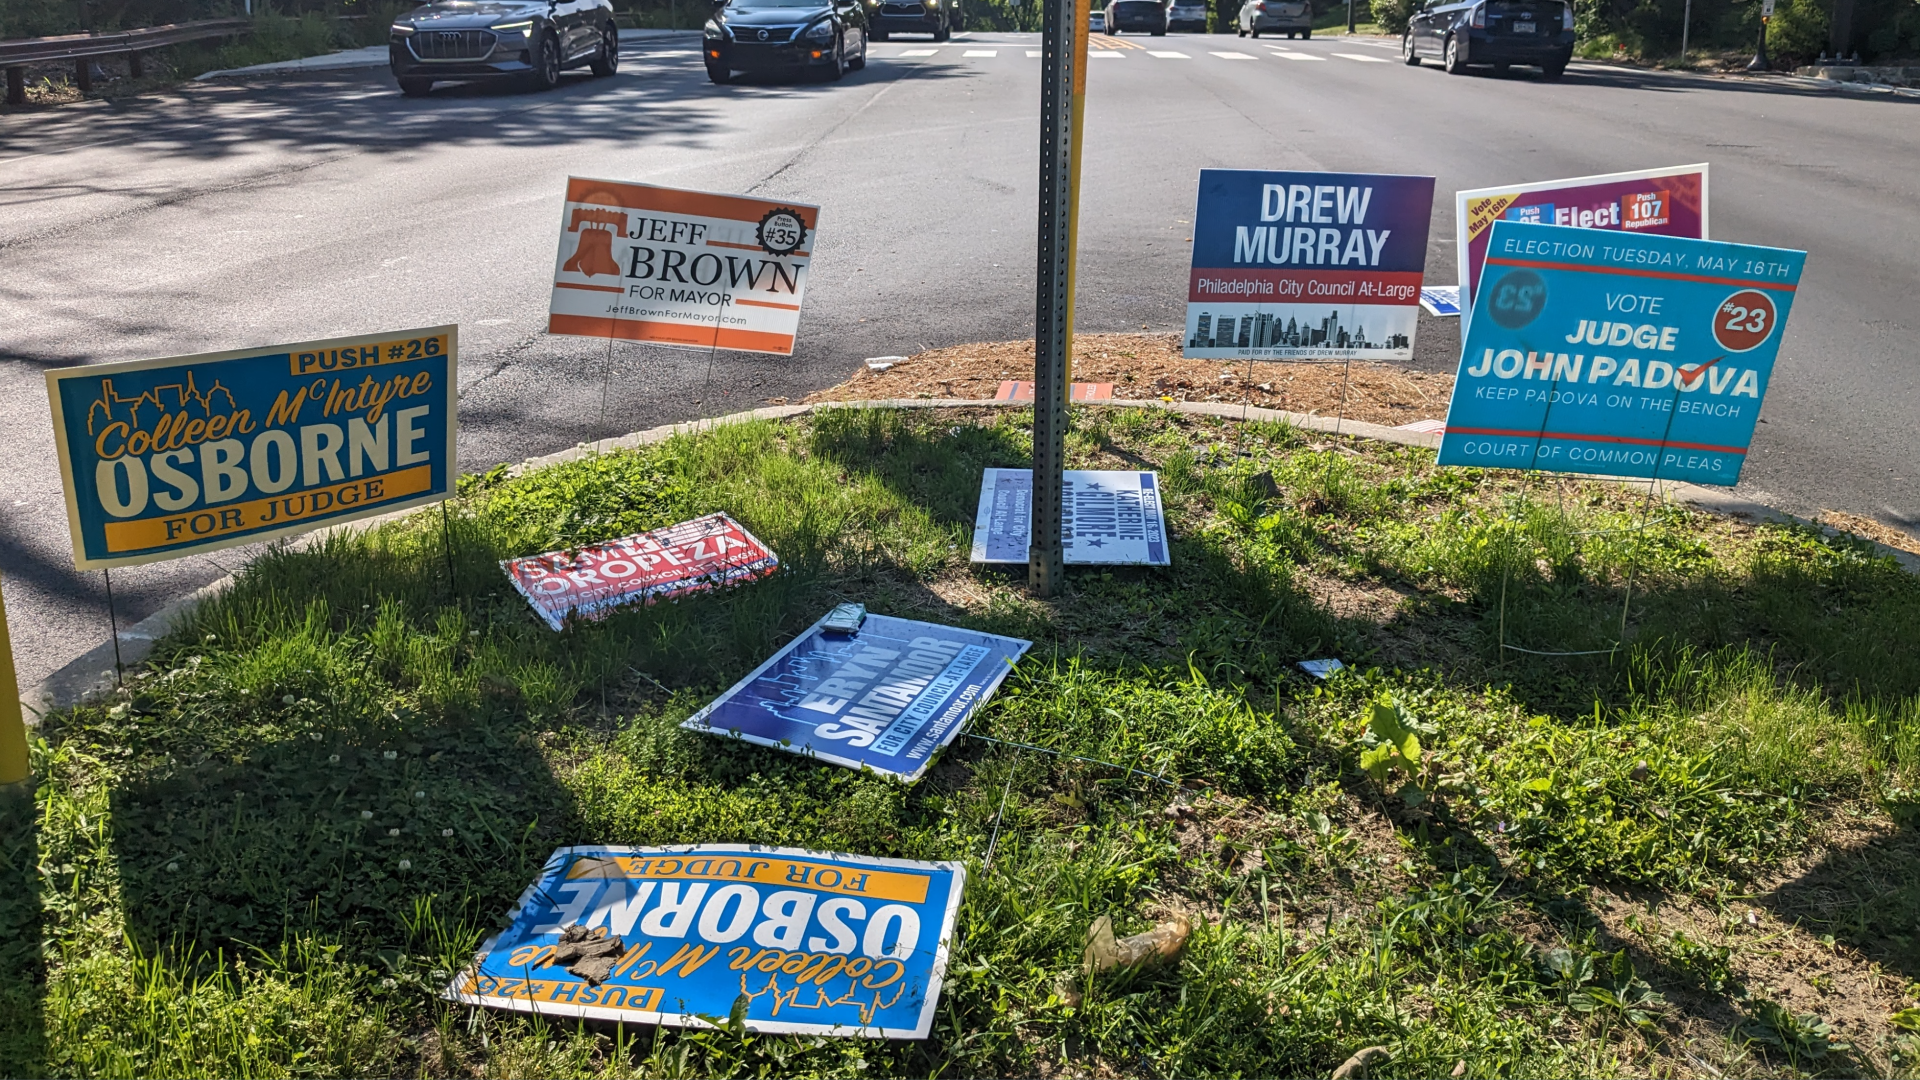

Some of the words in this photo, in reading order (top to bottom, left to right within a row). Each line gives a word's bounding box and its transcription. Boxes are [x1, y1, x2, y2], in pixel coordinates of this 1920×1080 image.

[1260, 184, 1372, 225] DREW
[1471, 197, 1492, 217] Vote
[1520, 206, 1540, 216] Push
[1631, 200, 1662, 219] 107
[1636, 192, 1656, 202] Push
[774, 221, 793, 229] Button
[776, 215, 792, 224] Press
[1469, 214, 1489, 235] May
[1486, 197, 1509, 219] 16th
[1555, 202, 1620, 228] Elect
[1625, 217, 1669, 229] Republican
[629, 217, 707, 245] JEFF
[765, 227, 797, 246] #35
[1233, 226, 1391, 266] MURRAY
[625, 245, 804, 295] BROWN
[1504, 239, 1595, 259] ELECTION
[1602, 246, 1689, 269] TUESDAY,
[1697, 256, 1738, 272] MAY
[1743, 260, 1790, 277] 16TH
[629, 285, 665, 300] FOR
[669, 290, 732, 307] MAYOR
[1197, 278, 1274, 298] Philadelphia
[1279, 279, 1303, 298] City
[1307, 280, 1355, 297] Council
[1358, 281, 1415, 300] At-Large
[1605, 293, 1664, 315] VOTE
[605, 305, 747, 325] JeffBrownForMayor.com
[1722, 302, 1766, 333] #23
[1565, 319, 1679, 351] JUDGE
[298, 350, 380, 373] PUSH
[388, 337, 441, 361] #26
[1468, 348, 1585, 384] JOHN
[1588, 358, 1759, 398] PADOVA
[95, 408, 256, 461] Colleen
[266, 370, 432, 424] McIntyre
[1476, 387, 1519, 400] KEEP
[1525, 389, 1598, 406] PADOVA
[1606, 395, 1632, 408] ON
[1638, 397, 1672, 412] THE
[1679, 401, 1741, 418] BENCH
[95, 404, 430, 518] OSBORNE
[1463, 441, 1529, 457] COURT
[1536, 445, 1562, 459] OF
[1569, 447, 1657, 466] COMMON
[1664, 454, 1723, 471] PLEAS
[164, 508, 245, 541] FOR
[260, 479, 385, 522] JUDGE
[996, 489, 1010, 510] Council
[1014, 489, 1028, 514] Democrat
[1075, 492, 1117, 537] GILMORE
[1013, 515, 1026, 524] for
[1116, 490, 1144, 540] KATHERINE
[1010, 524, 1026, 537] City
[533, 535, 749, 595] OROPEZA
[545, 595, 578, 607] FOR
[580, 585, 614, 598] CITY
[618, 568, 684, 588] COUNCIL
[798, 646, 901, 714] ERYN
[814, 636, 966, 747] SANTAMOOR
[876, 735, 900, 753] FOR
[896, 714, 923, 736] CITY
[912, 647, 985, 715] COUNCIL-AT-LARGE
[906, 684, 982, 760] www.santamoor.com
[629, 858, 770, 879] JUDGE
[787, 864, 871, 892] FOR
[531, 880, 920, 962] OSBORNE
[728, 945, 905, 989] Colleen
[474, 979, 545, 997] #26
[550, 982, 654, 1009] PUSH
